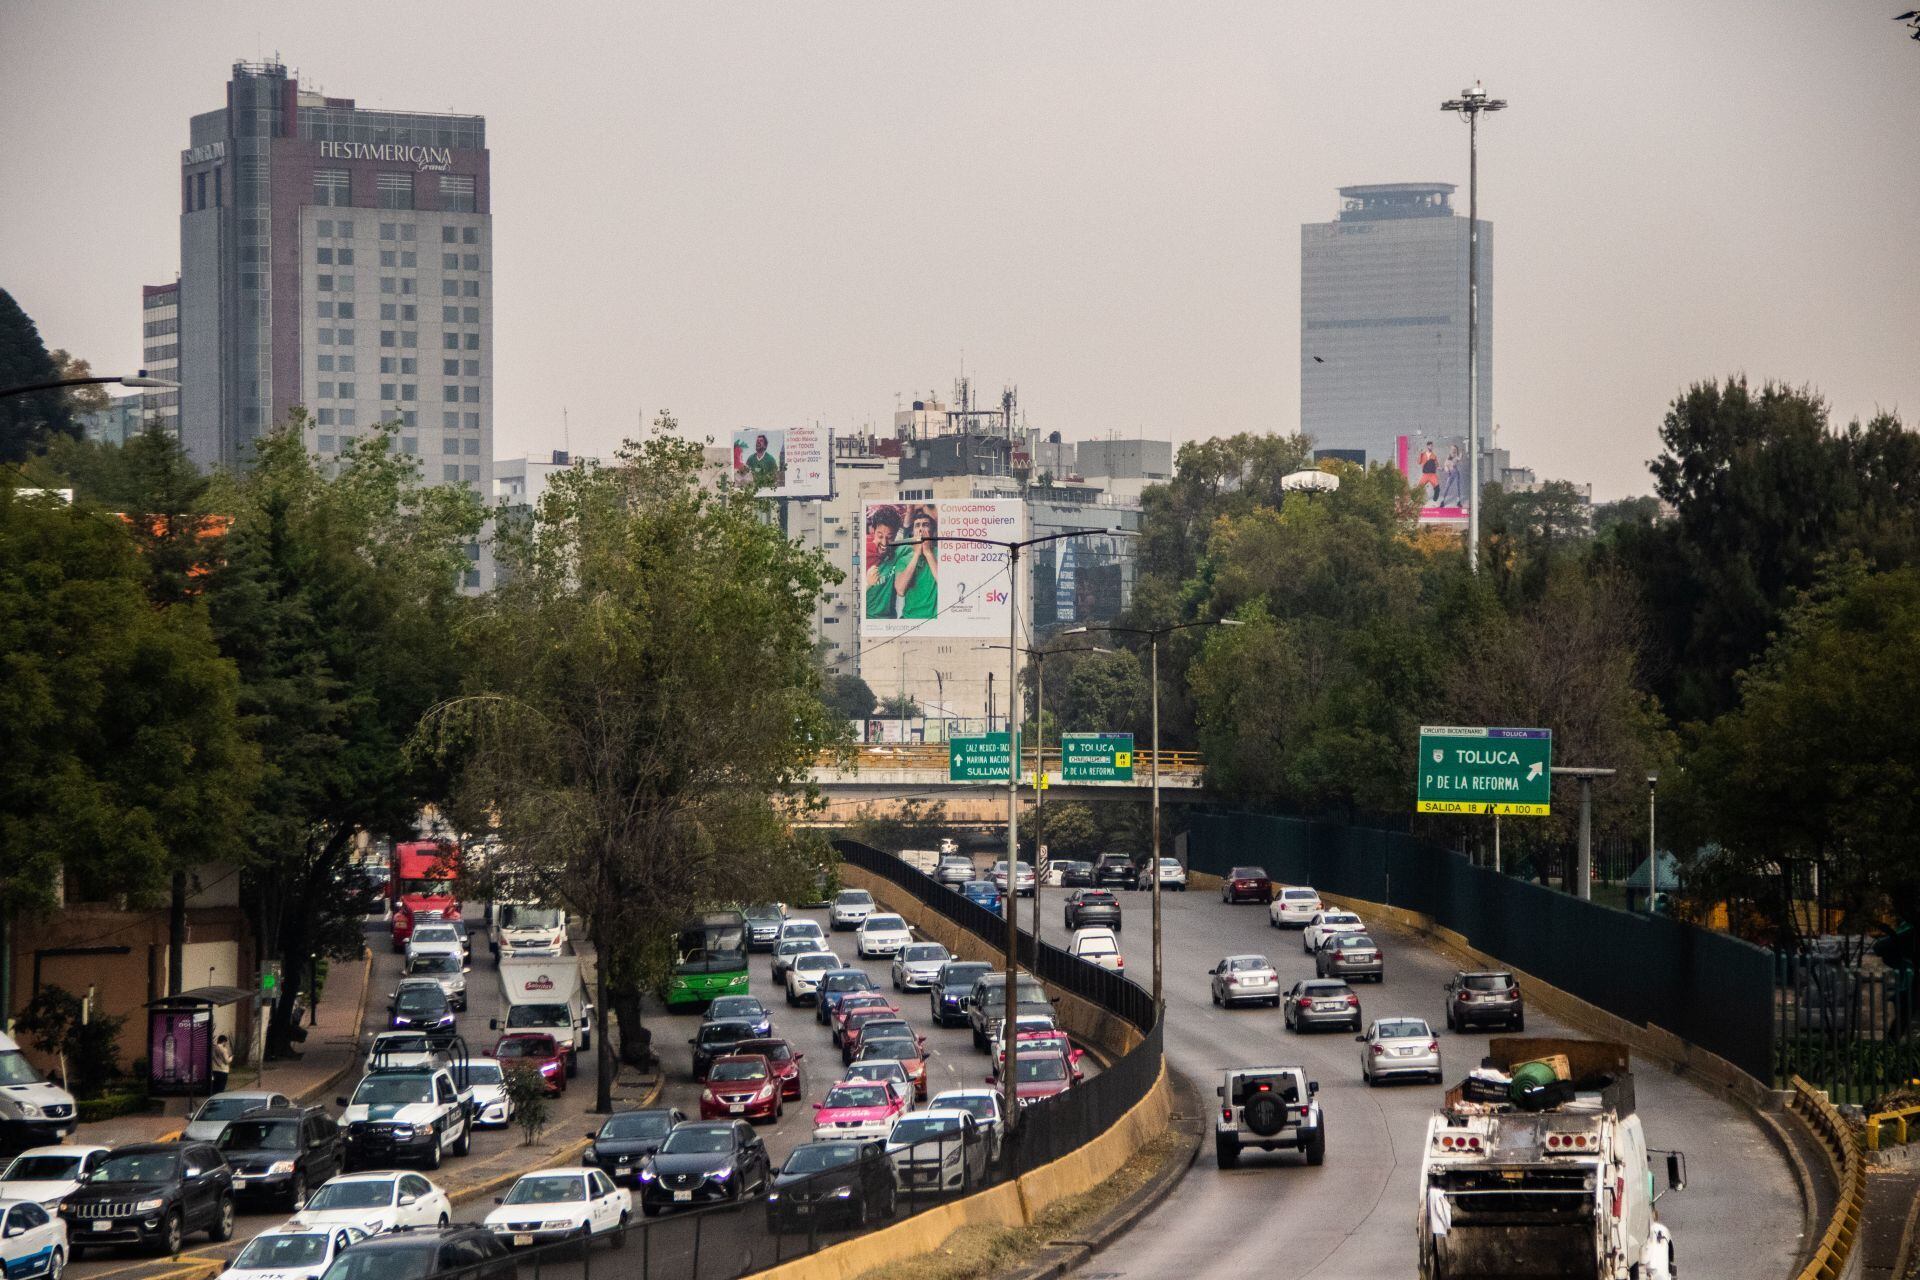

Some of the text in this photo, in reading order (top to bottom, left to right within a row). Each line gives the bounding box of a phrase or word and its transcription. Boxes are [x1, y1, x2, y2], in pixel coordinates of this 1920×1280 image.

[320, 140, 452, 164] FIESTAMERICANA
[941, 504, 996, 512] Convocamos
[948, 515, 961, 525] los
[962, 517, 980, 527] que
[981, 515, 1015, 526] quieren
[957, 528, 988, 537] TODOS
[941, 541, 993, 551] los partidos
[941, 553, 952, 562] de
[953, 553, 979, 564] Qatar
[986, 589, 1009, 605] sky
[965, 744, 977, 752] CALZ
[1080, 743, 1115, 752] TOLUCA
[966, 756, 988, 764] MARINA
[1456, 749, 1520, 765] TOLUCA
[967, 767, 1010, 776] SULLIVAN
[1064, 767, 1115, 776] P DE LA REFORMA
[1426, 775, 1520, 791] P DE LA REFORMA
[1425, 803, 1462, 812] SALIDA
[1468, 803, 1477, 812] 18
[1504, 805, 1511, 813] A
[1515, 805, 1531, 814] 100
